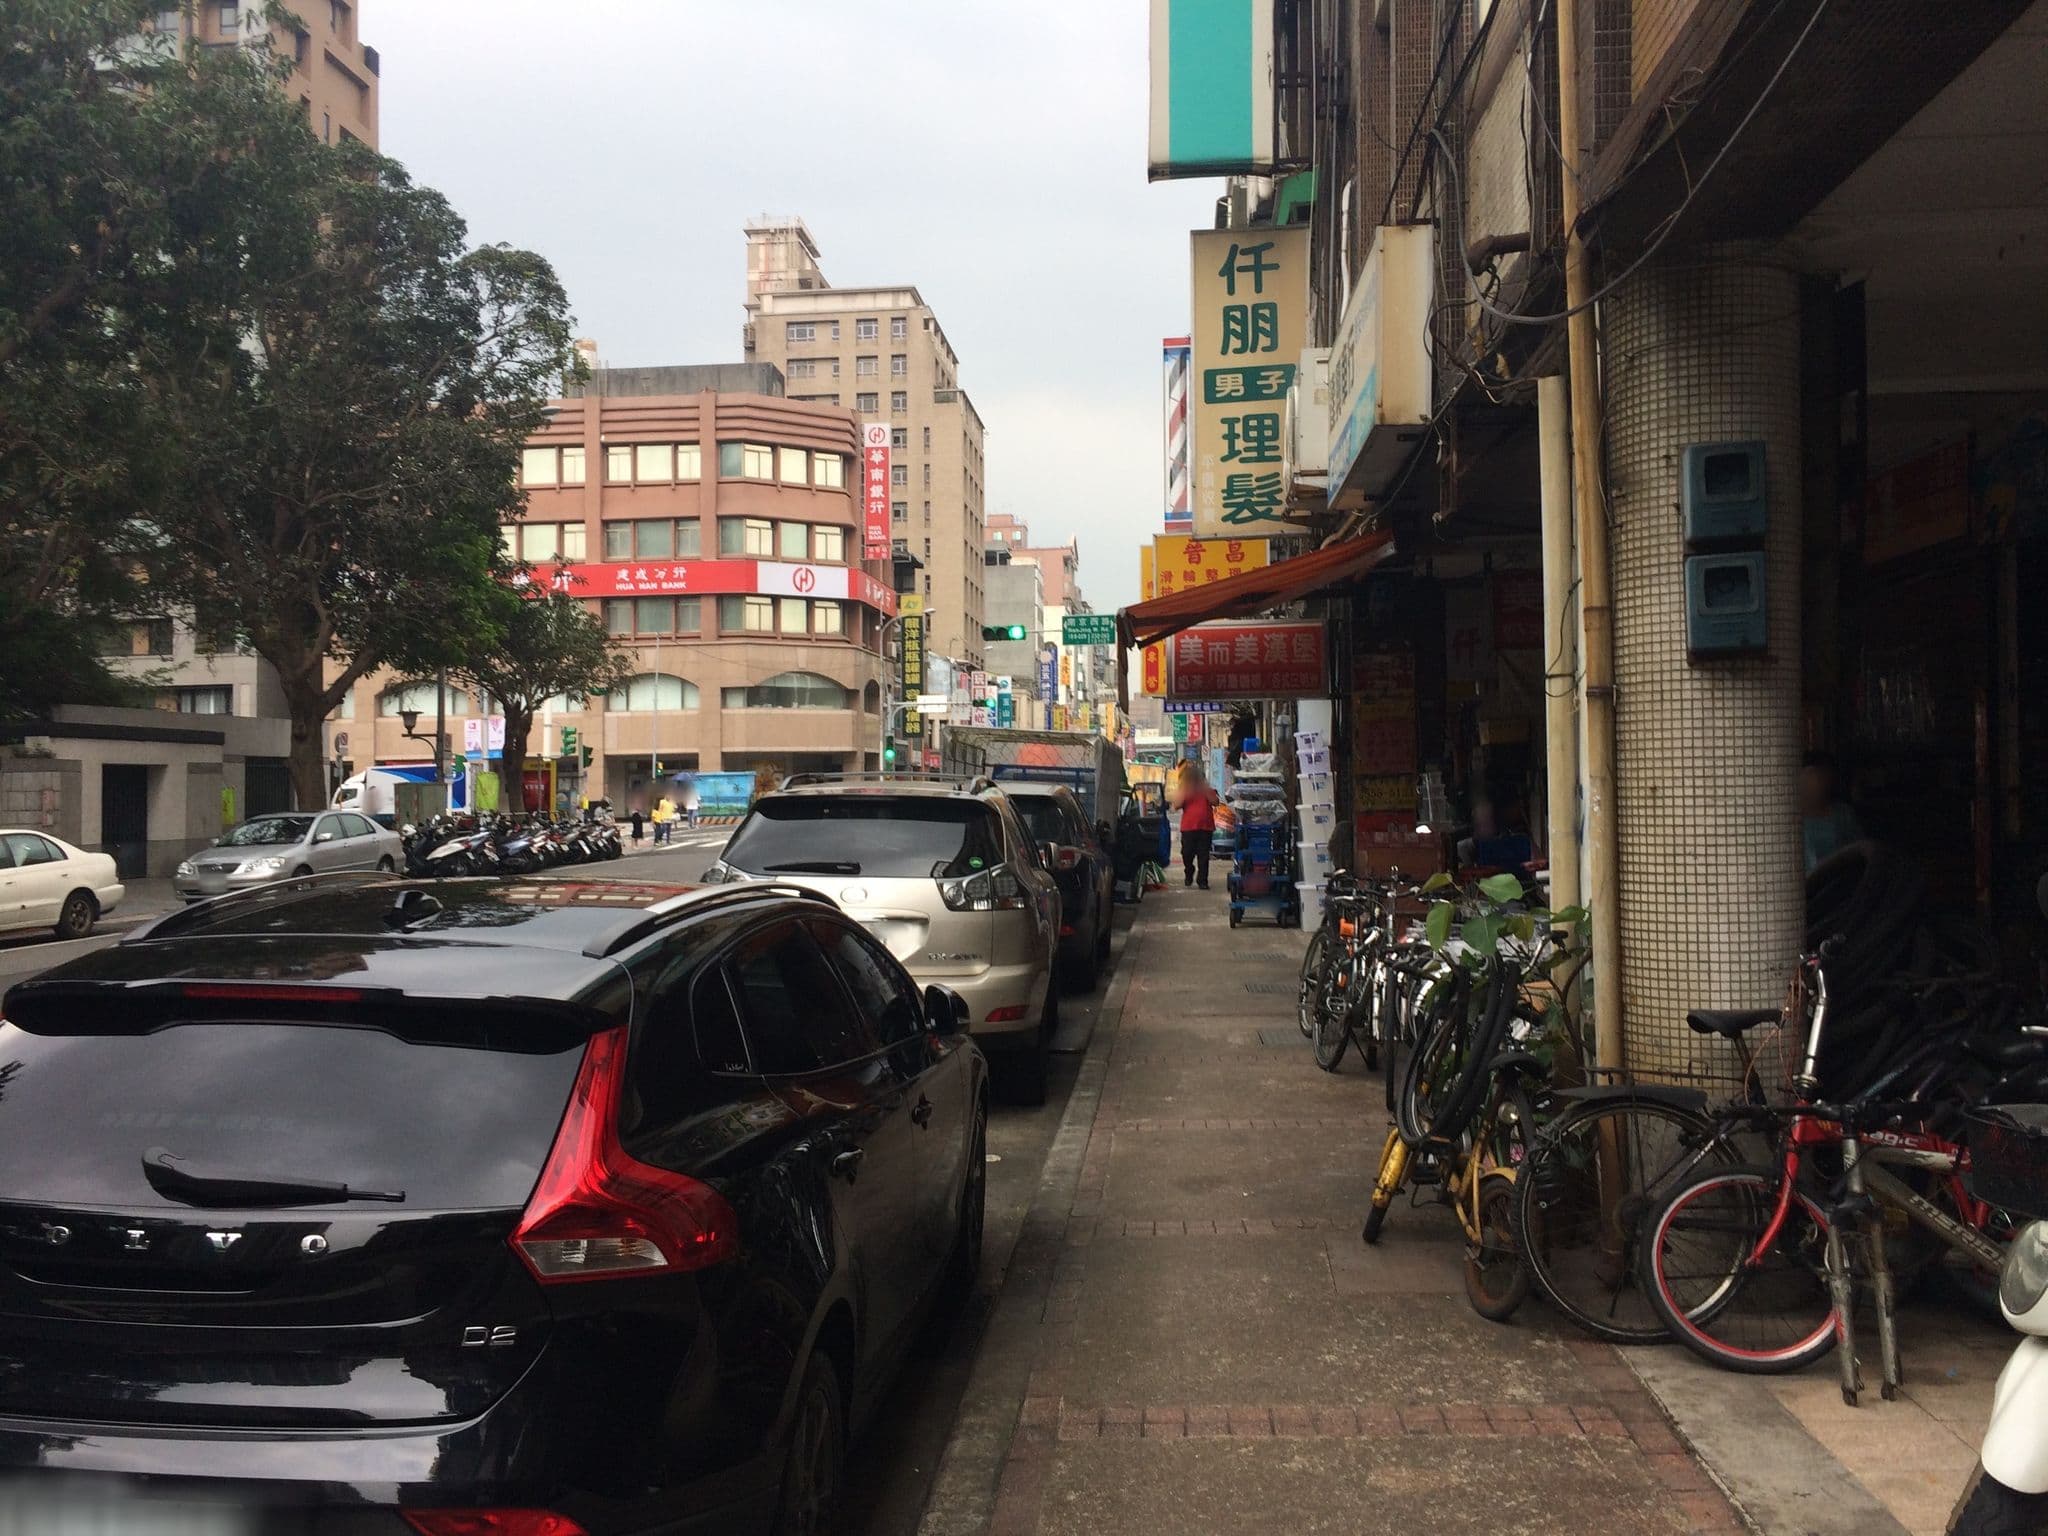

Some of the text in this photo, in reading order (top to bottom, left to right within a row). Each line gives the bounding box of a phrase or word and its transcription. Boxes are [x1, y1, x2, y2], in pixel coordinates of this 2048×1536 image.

[1218, 241, 1280, 355] 仟朋
[1215, 370, 1286, 398] 男子
[869, 450, 885, 514] 華南銀行
[1220, 413, 1283, 525] 理髮
[615, 582, 687, 591] HUA NAN BANK
[1179, 633, 1317, 666] 美而美漢堡
[48, 1225, 329, 1254] OLVO
[460, 1325, 518, 1347] D2
